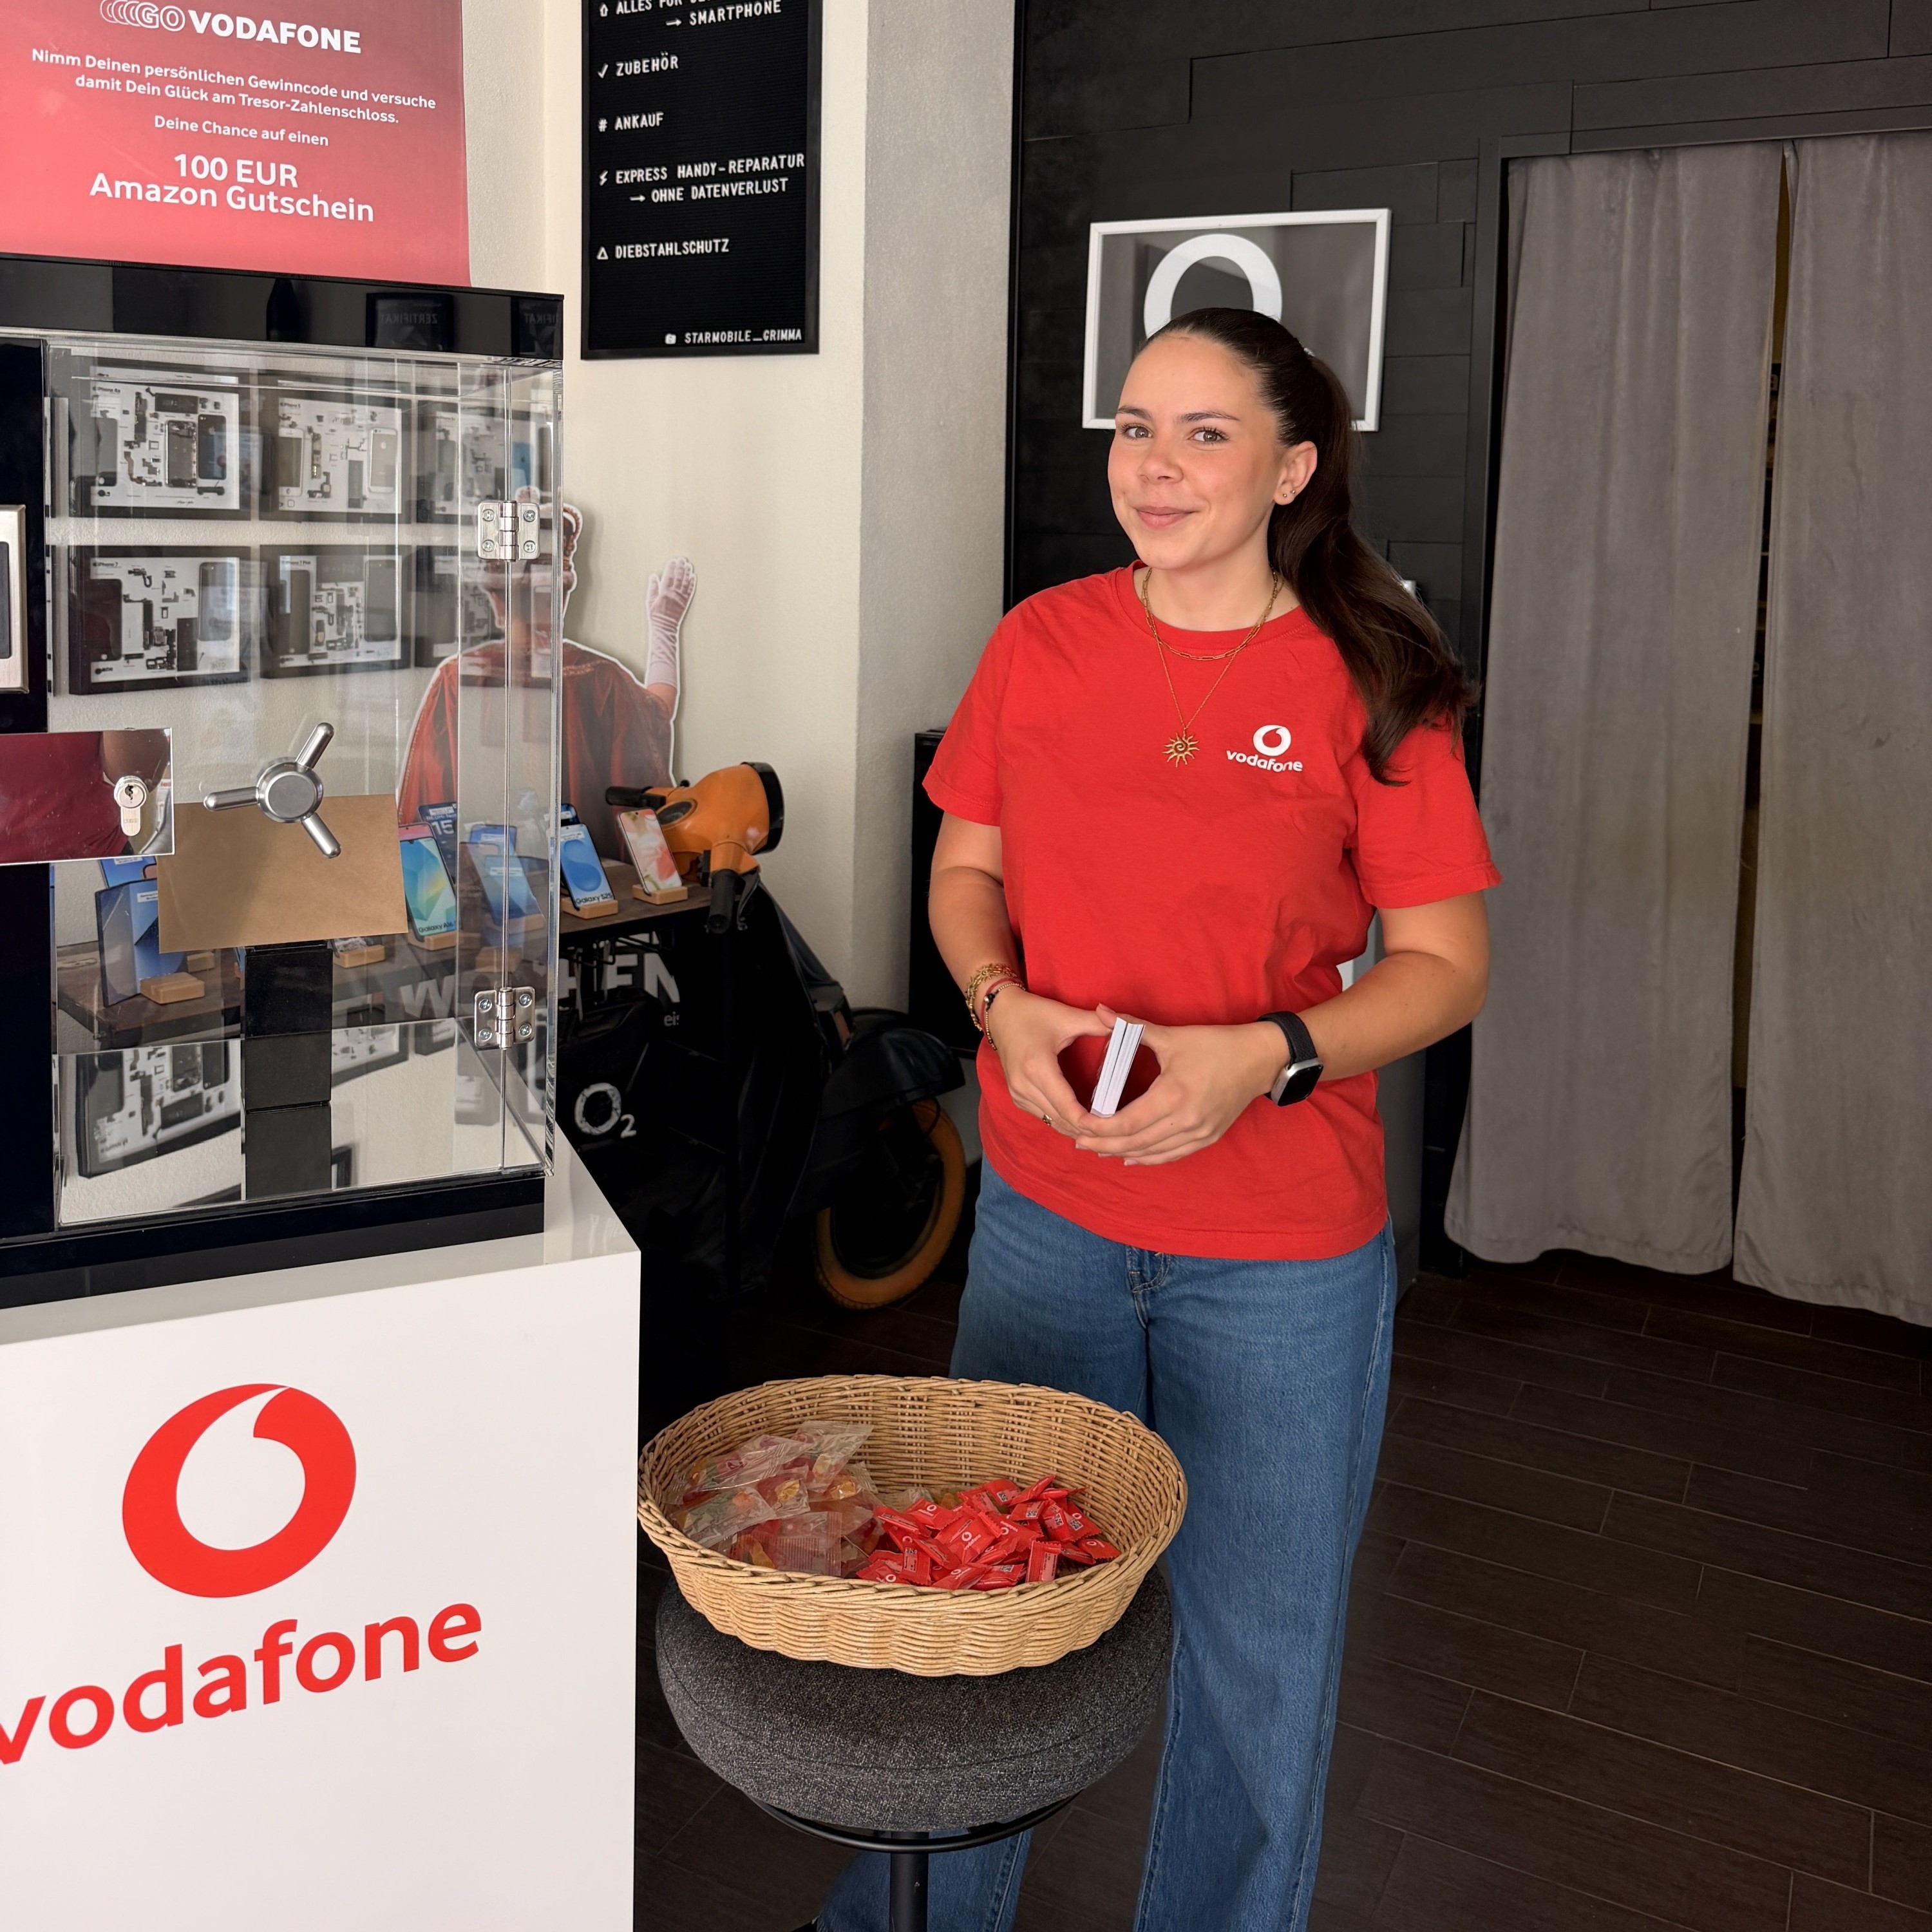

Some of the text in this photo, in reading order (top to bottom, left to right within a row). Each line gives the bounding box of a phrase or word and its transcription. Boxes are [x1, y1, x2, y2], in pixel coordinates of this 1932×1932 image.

[616, 0, 652, 15] ALLES
[690, 0, 782, 26] SMARTPHONE
[189, 10, 361, 53] VODAFONE
[616, 51, 679, 77] ZUBEHÖR
[32, 48, 437, 109] Nimm Deinen persönlichen Gewinncode und versuche
[75, 74, 399, 123] damit Dein Glück am Tresor-Zahlenschloss.
[155, 115, 329, 146] Deine Chance auf einen
[615, 112, 664, 130] ANKAUF
[175, 153, 298, 187] 100 EUR
[616, 153, 805, 184] EXPRESS HANDY-REPARATUR
[90, 173, 374, 222] Amazon Gutschein
[651, 177, 789, 203] OHNE DATENVERLUST
[616, 238, 730, 258] DIEBSTAHLSCHUTZ
[684, 329, 802, 344] STARMOBILE_GRIMMA
[1226, 750, 1303, 772] vodafone
[576, 895, 600, 904] Galaxy
[419, 923, 442, 933] Galaxy
[0, 1603, 482, 1765] vodafone
